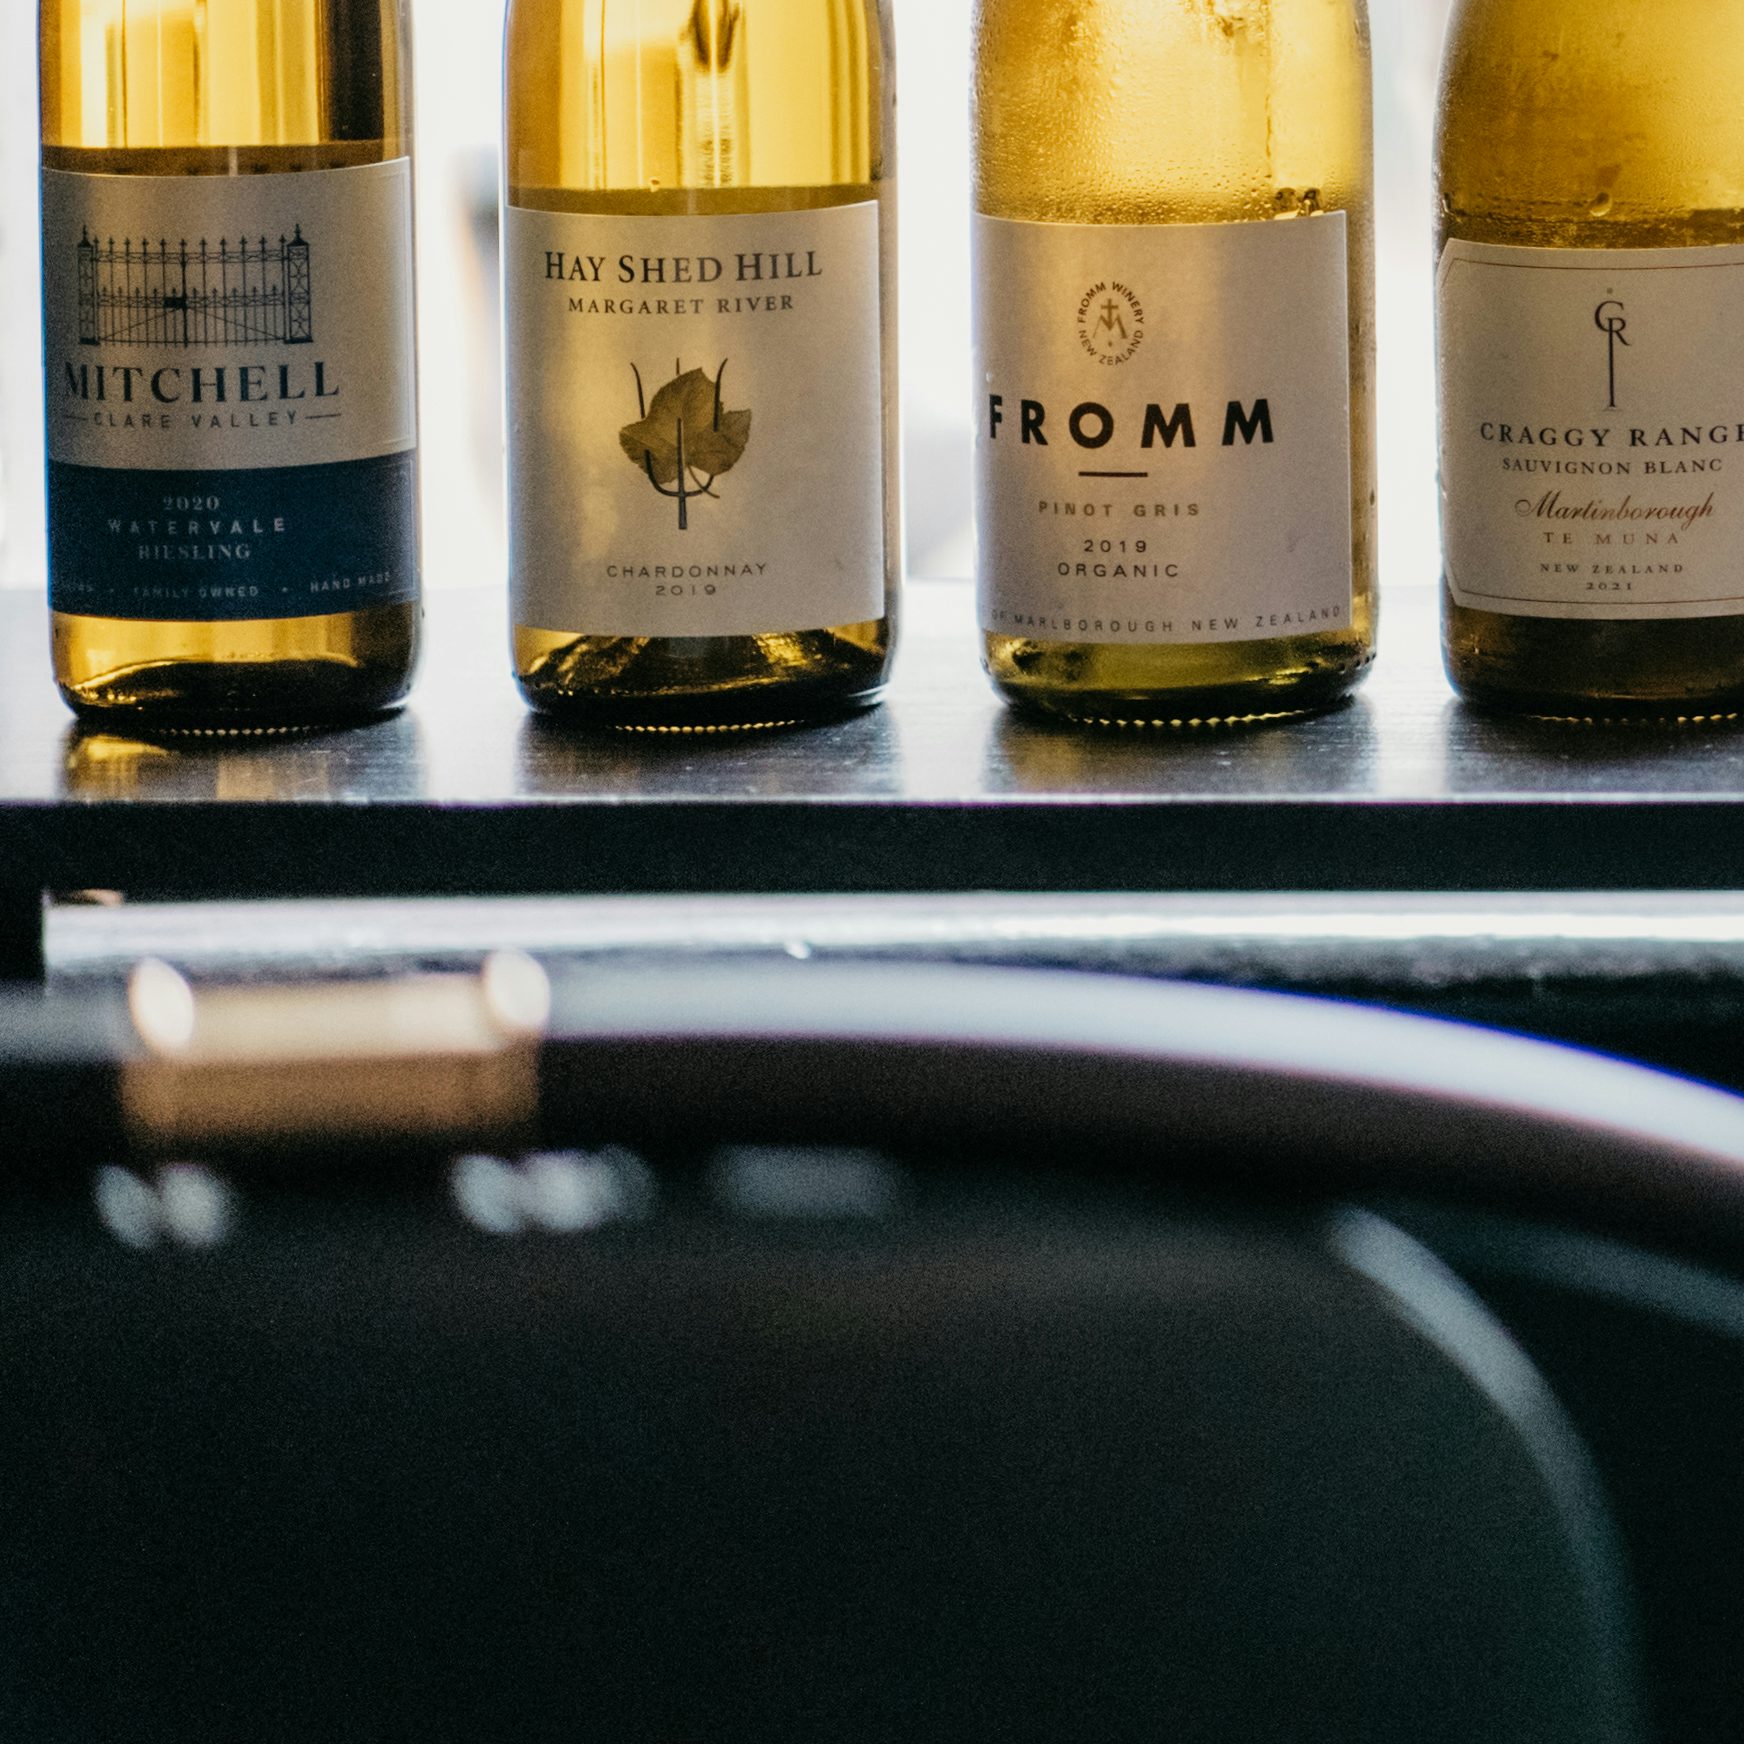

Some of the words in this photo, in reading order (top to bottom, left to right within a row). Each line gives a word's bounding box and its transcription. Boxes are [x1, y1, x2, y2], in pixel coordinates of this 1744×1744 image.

[544, 250, 606, 282] HAY
[617, 253, 723, 284] SHED
[735, 249, 824, 282] HILL
[568, 296, 704, 315] MARGARET
[716, 294, 794, 314] RIVER
[1077, 281, 1107, 325] FROMM
[1111, 280, 1145, 325] WINERY
[1078, 329, 1098, 357] NEW
[1098, 329, 1145, 366] ZEALAND
[65, 361, 341, 403] MITCHELL
[94, 411, 172, 429] CLARE
[191, 410, 298, 428] VALLEY
[989, 393, 1275, 449] FROMM
[1479, 422, 1611, 448] CRAGGY
[1501, 456, 1632, 475] SAUVIGNON
[1643, 457, 1723, 475] BLANC
[162, 495, 221, 512] 2020
[1038, 500, 1114, 518] PINOT
[1133, 502, 1200, 518] GRIS
[1513, 489, 1715, 531] Martinborough
[107, 517, 286, 535] WATERVALE
[1083, 539, 1148, 554] 2019
[1542, 531, 1573, 545] TE
[1594, 531, 1680, 546] MUNA
[138, 543, 251, 561] RIESLING
[606, 562, 767, 578] CHARDONNAY
[1057, 562, 1180, 578] ORGANIC
[1539, 563, 1581, 574] NEW
[1591, 563, 1685, 575] ZEALAND
[199, 585, 258, 599] OWNED
[309, 577, 351, 593] HAND
[654, 583, 717, 597] 2019
[1013, 613, 1174, 633] MARLBOROUGH
[1191, 617, 1239, 632] NEW
[1255, 604, 1342, 629] ZEALAND
